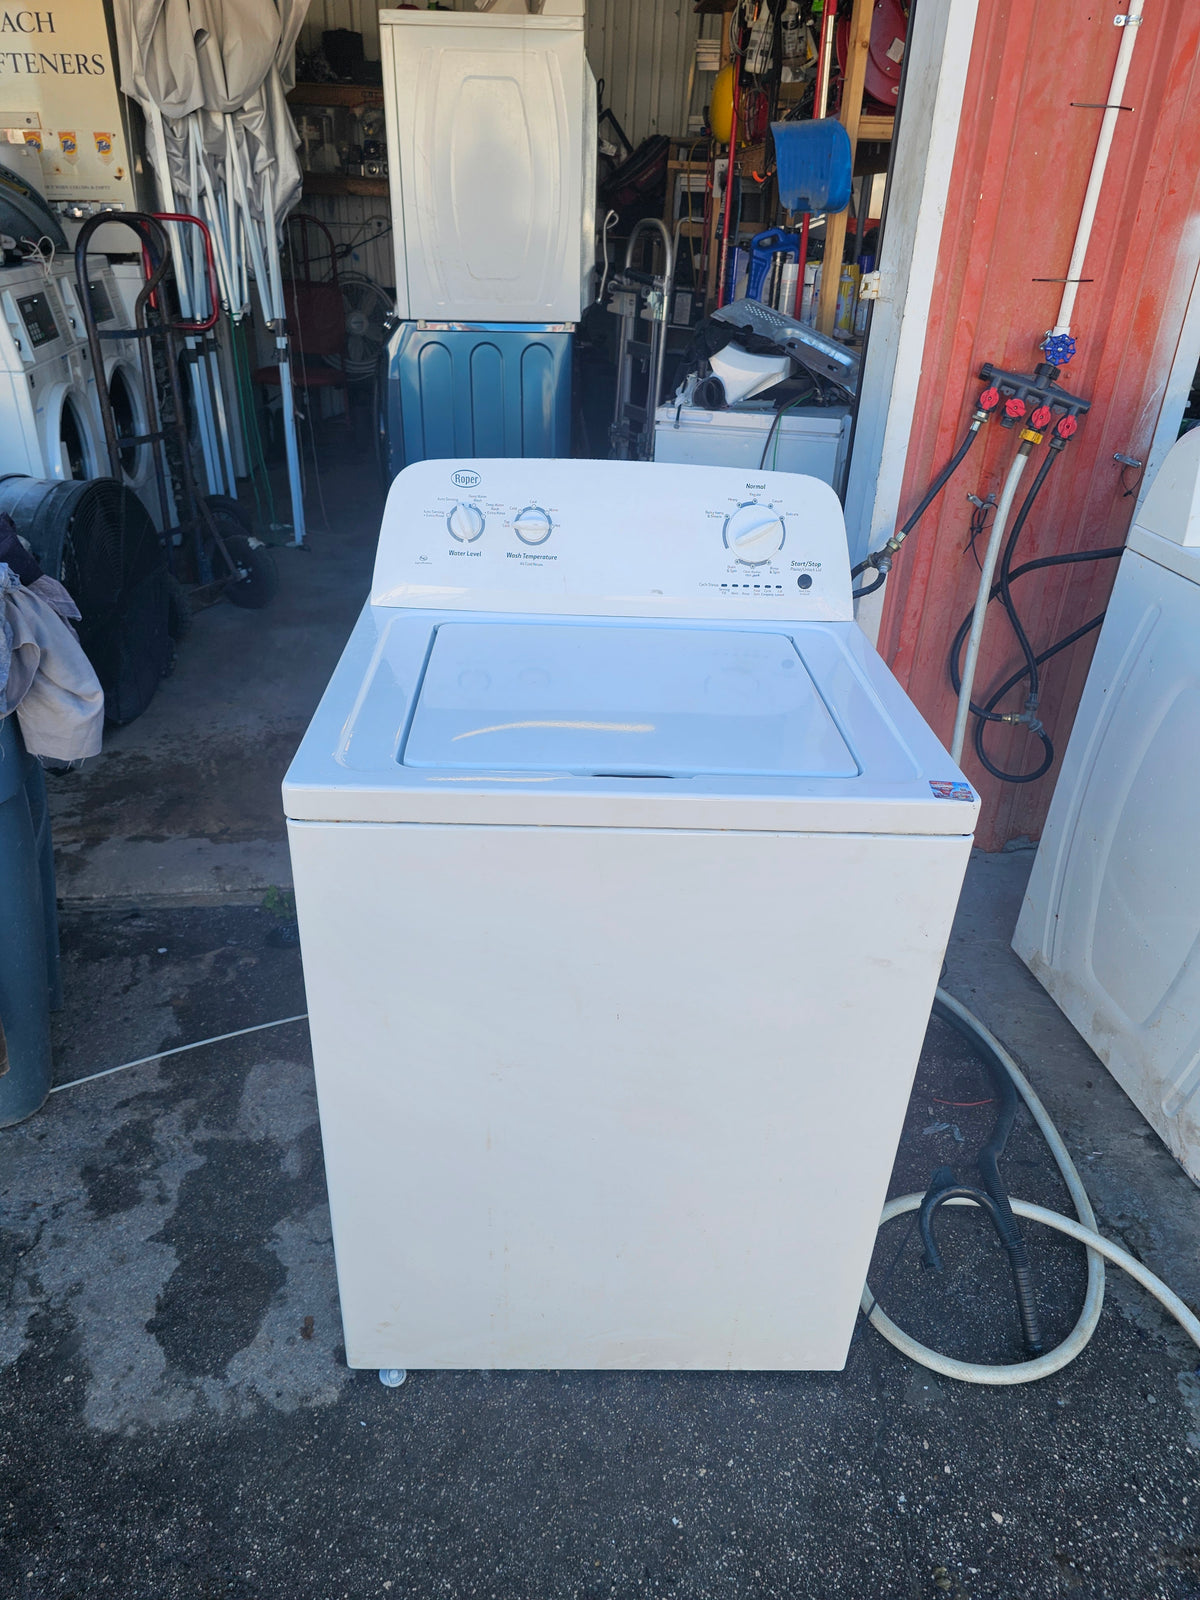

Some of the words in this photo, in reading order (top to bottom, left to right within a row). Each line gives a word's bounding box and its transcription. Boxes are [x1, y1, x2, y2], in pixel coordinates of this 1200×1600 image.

[1, 11, 56, 33] ACH
[61, 139, 76, 152] Tide
[96, 139, 111, 152] Tide
[454, 473, 479, 485] Roper
[448, 549, 466, 557] Water
[522, 552, 558, 561] Temperature
[790, 560, 822, 568] Start/Stop
